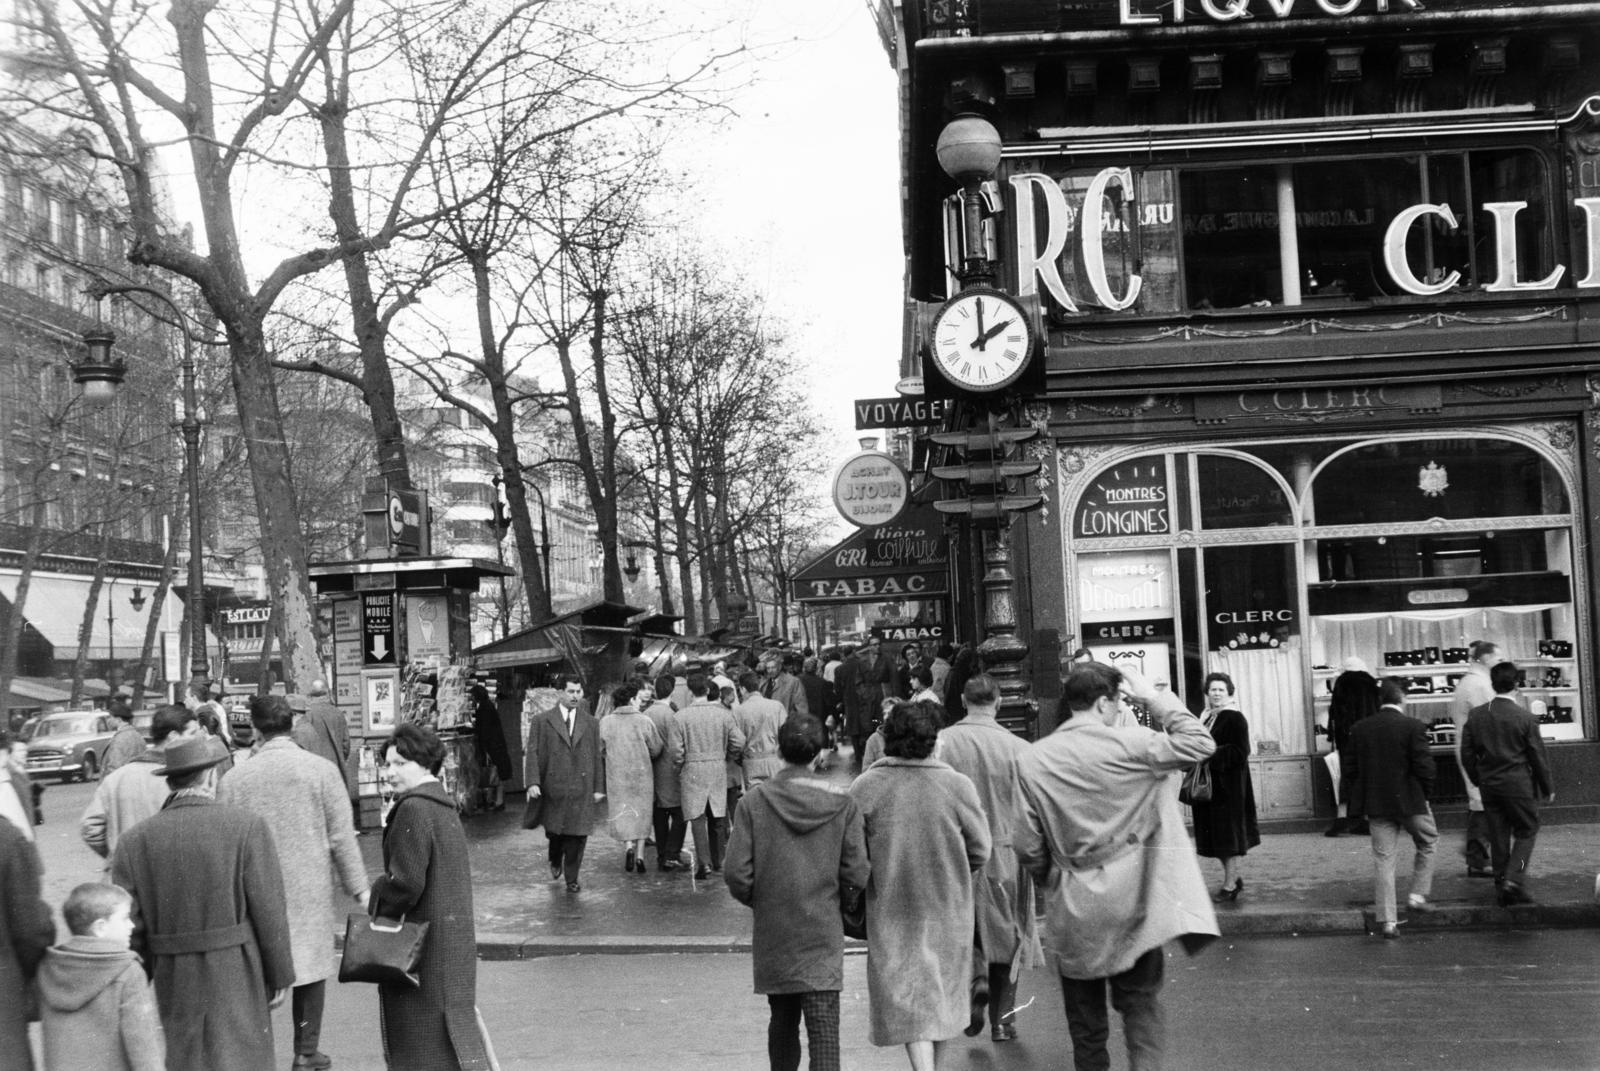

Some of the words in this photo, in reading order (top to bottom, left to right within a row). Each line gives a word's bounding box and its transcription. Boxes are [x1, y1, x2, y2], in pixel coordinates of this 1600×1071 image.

[1273, 386, 1401, 411] CLERC
[1106, 486, 1166, 501] MONTRES
[1081, 508, 1169, 535] LONGINES
[810, 575, 926, 597] TABAC
[366, 607, 391, 617] MOBILE
[1215, 609, 1293, 625] CLERC
[881, 626, 942, 640] TABAC
[1100, 625, 1155, 638] CLERC
